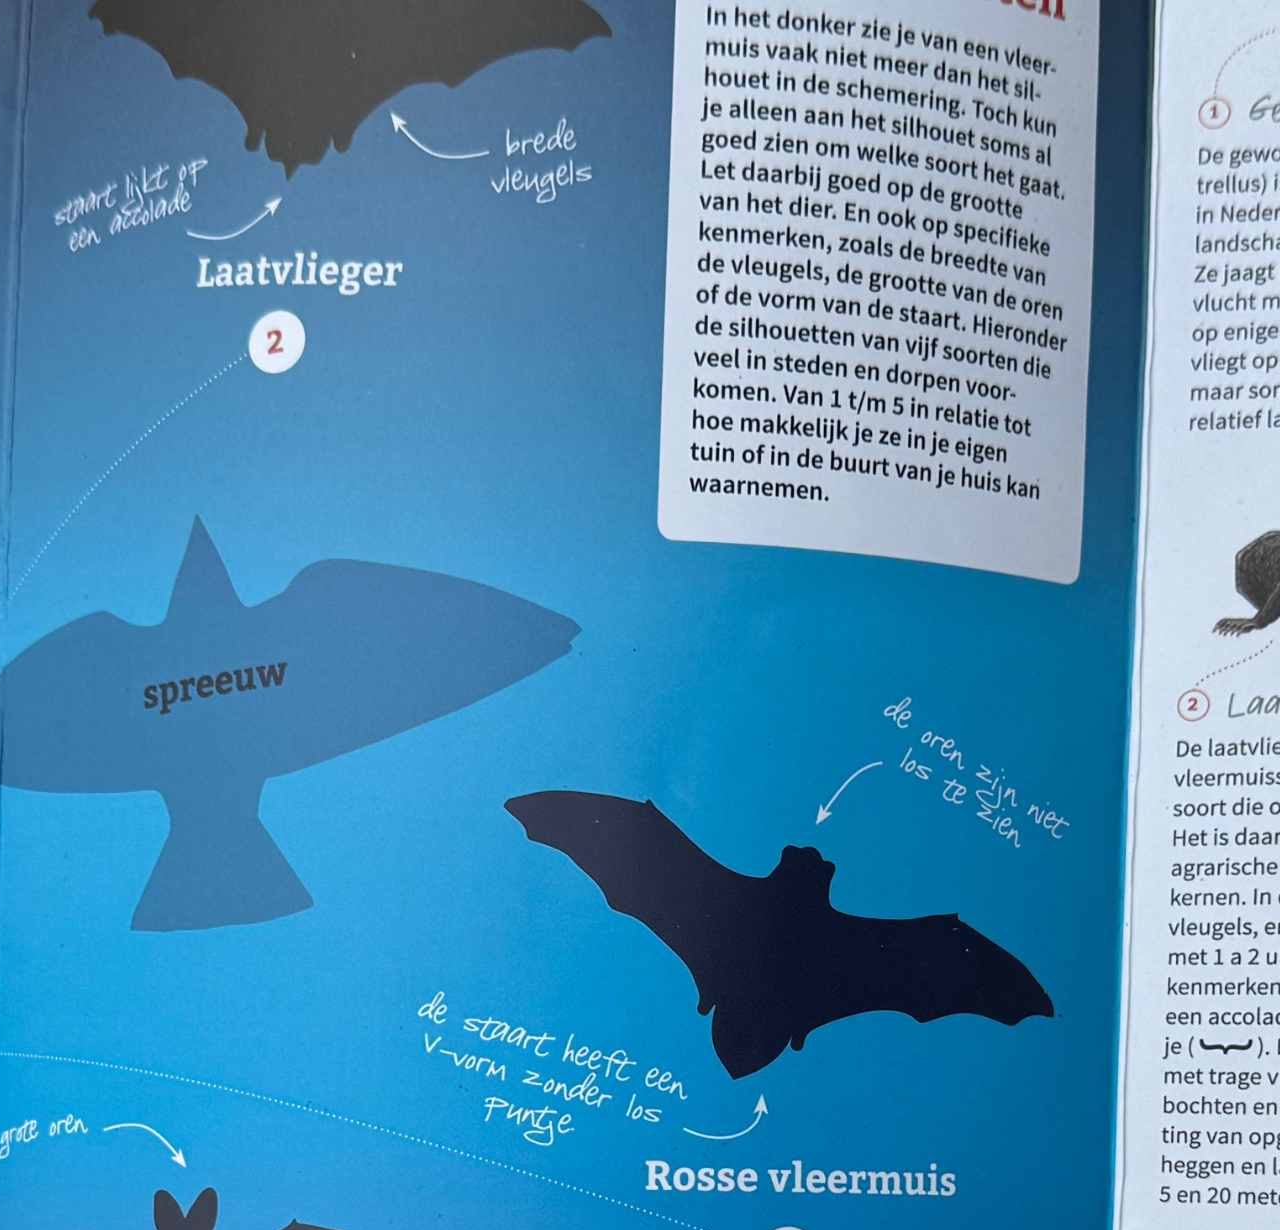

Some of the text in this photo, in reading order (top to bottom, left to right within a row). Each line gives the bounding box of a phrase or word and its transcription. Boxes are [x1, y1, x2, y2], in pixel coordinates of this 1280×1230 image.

[706, 37, 1040, 101] muis vaak niet meer dan het sil-
[1210, 104, 1218, 119] 1
[506, 118, 576, 156] brede
[1199, 147, 1223, 165] De
[55, 159, 208, 226] staart lijkt op
[491, 161, 592, 203] vleugels
[70, 182, 192, 251] een accolade
[197, 252, 403, 295] Laatvlieger
[267, 330, 284, 354] 2
[1190, 409, 1262, 431] relatief
[690, 478, 829, 501] waarnemen.
[144, 662, 288, 715] spreeuw
[1188, 698, 1198, 711] 2
[884, 697, 1070, 839] de oren zijn niet
[900, 748, 1021, 848] los te zien
[418, 991, 688, 1100] de staart heeft een
[424, 1033, 662, 1122] V-vorm zonder los
[49, 1115, 88, 1136] oren
[646, 1160, 956, 1196] Rosse vleermuis
[1159, 1186, 1170, 1202] 5
[1177, 1190, 1200, 1203] en
[1208, 1187, 1231, 1204] 20
